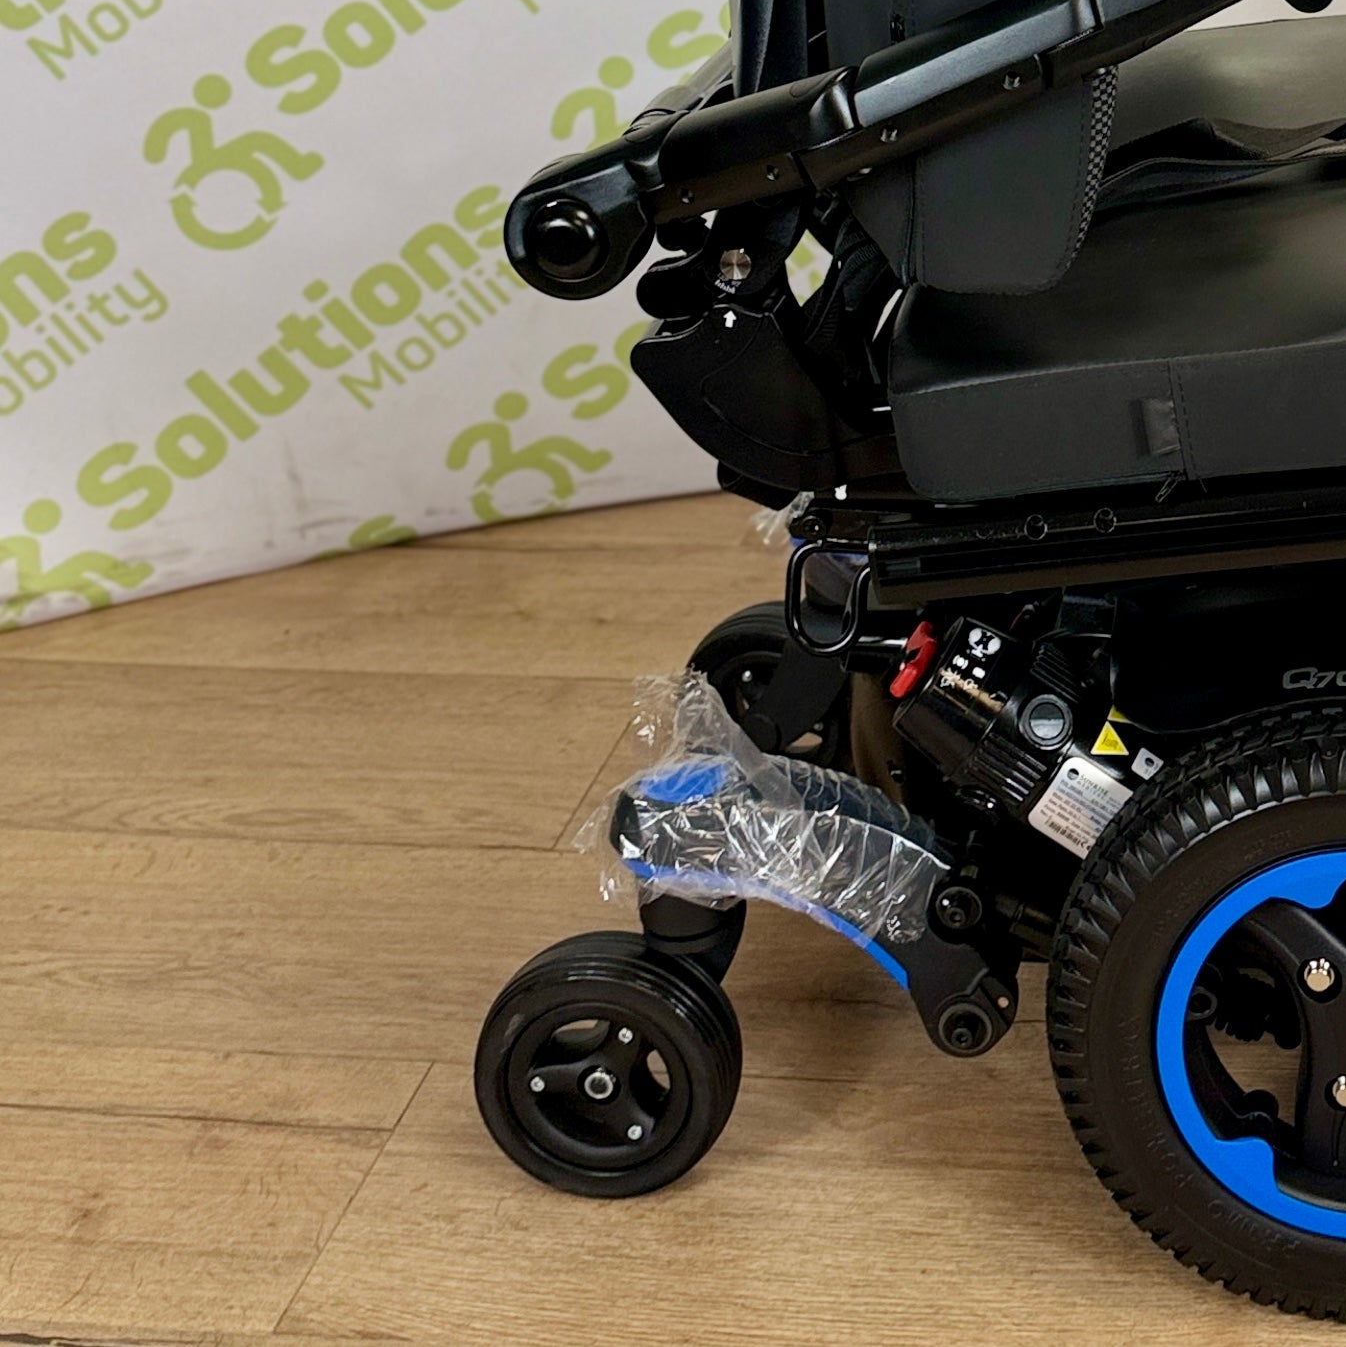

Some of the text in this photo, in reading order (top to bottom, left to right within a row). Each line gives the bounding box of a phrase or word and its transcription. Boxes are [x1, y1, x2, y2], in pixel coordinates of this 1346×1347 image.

[0, 268, 170, 417] obility
[76, 184, 508, 532] Solutions
[338, 258, 528, 411] Mobilit
